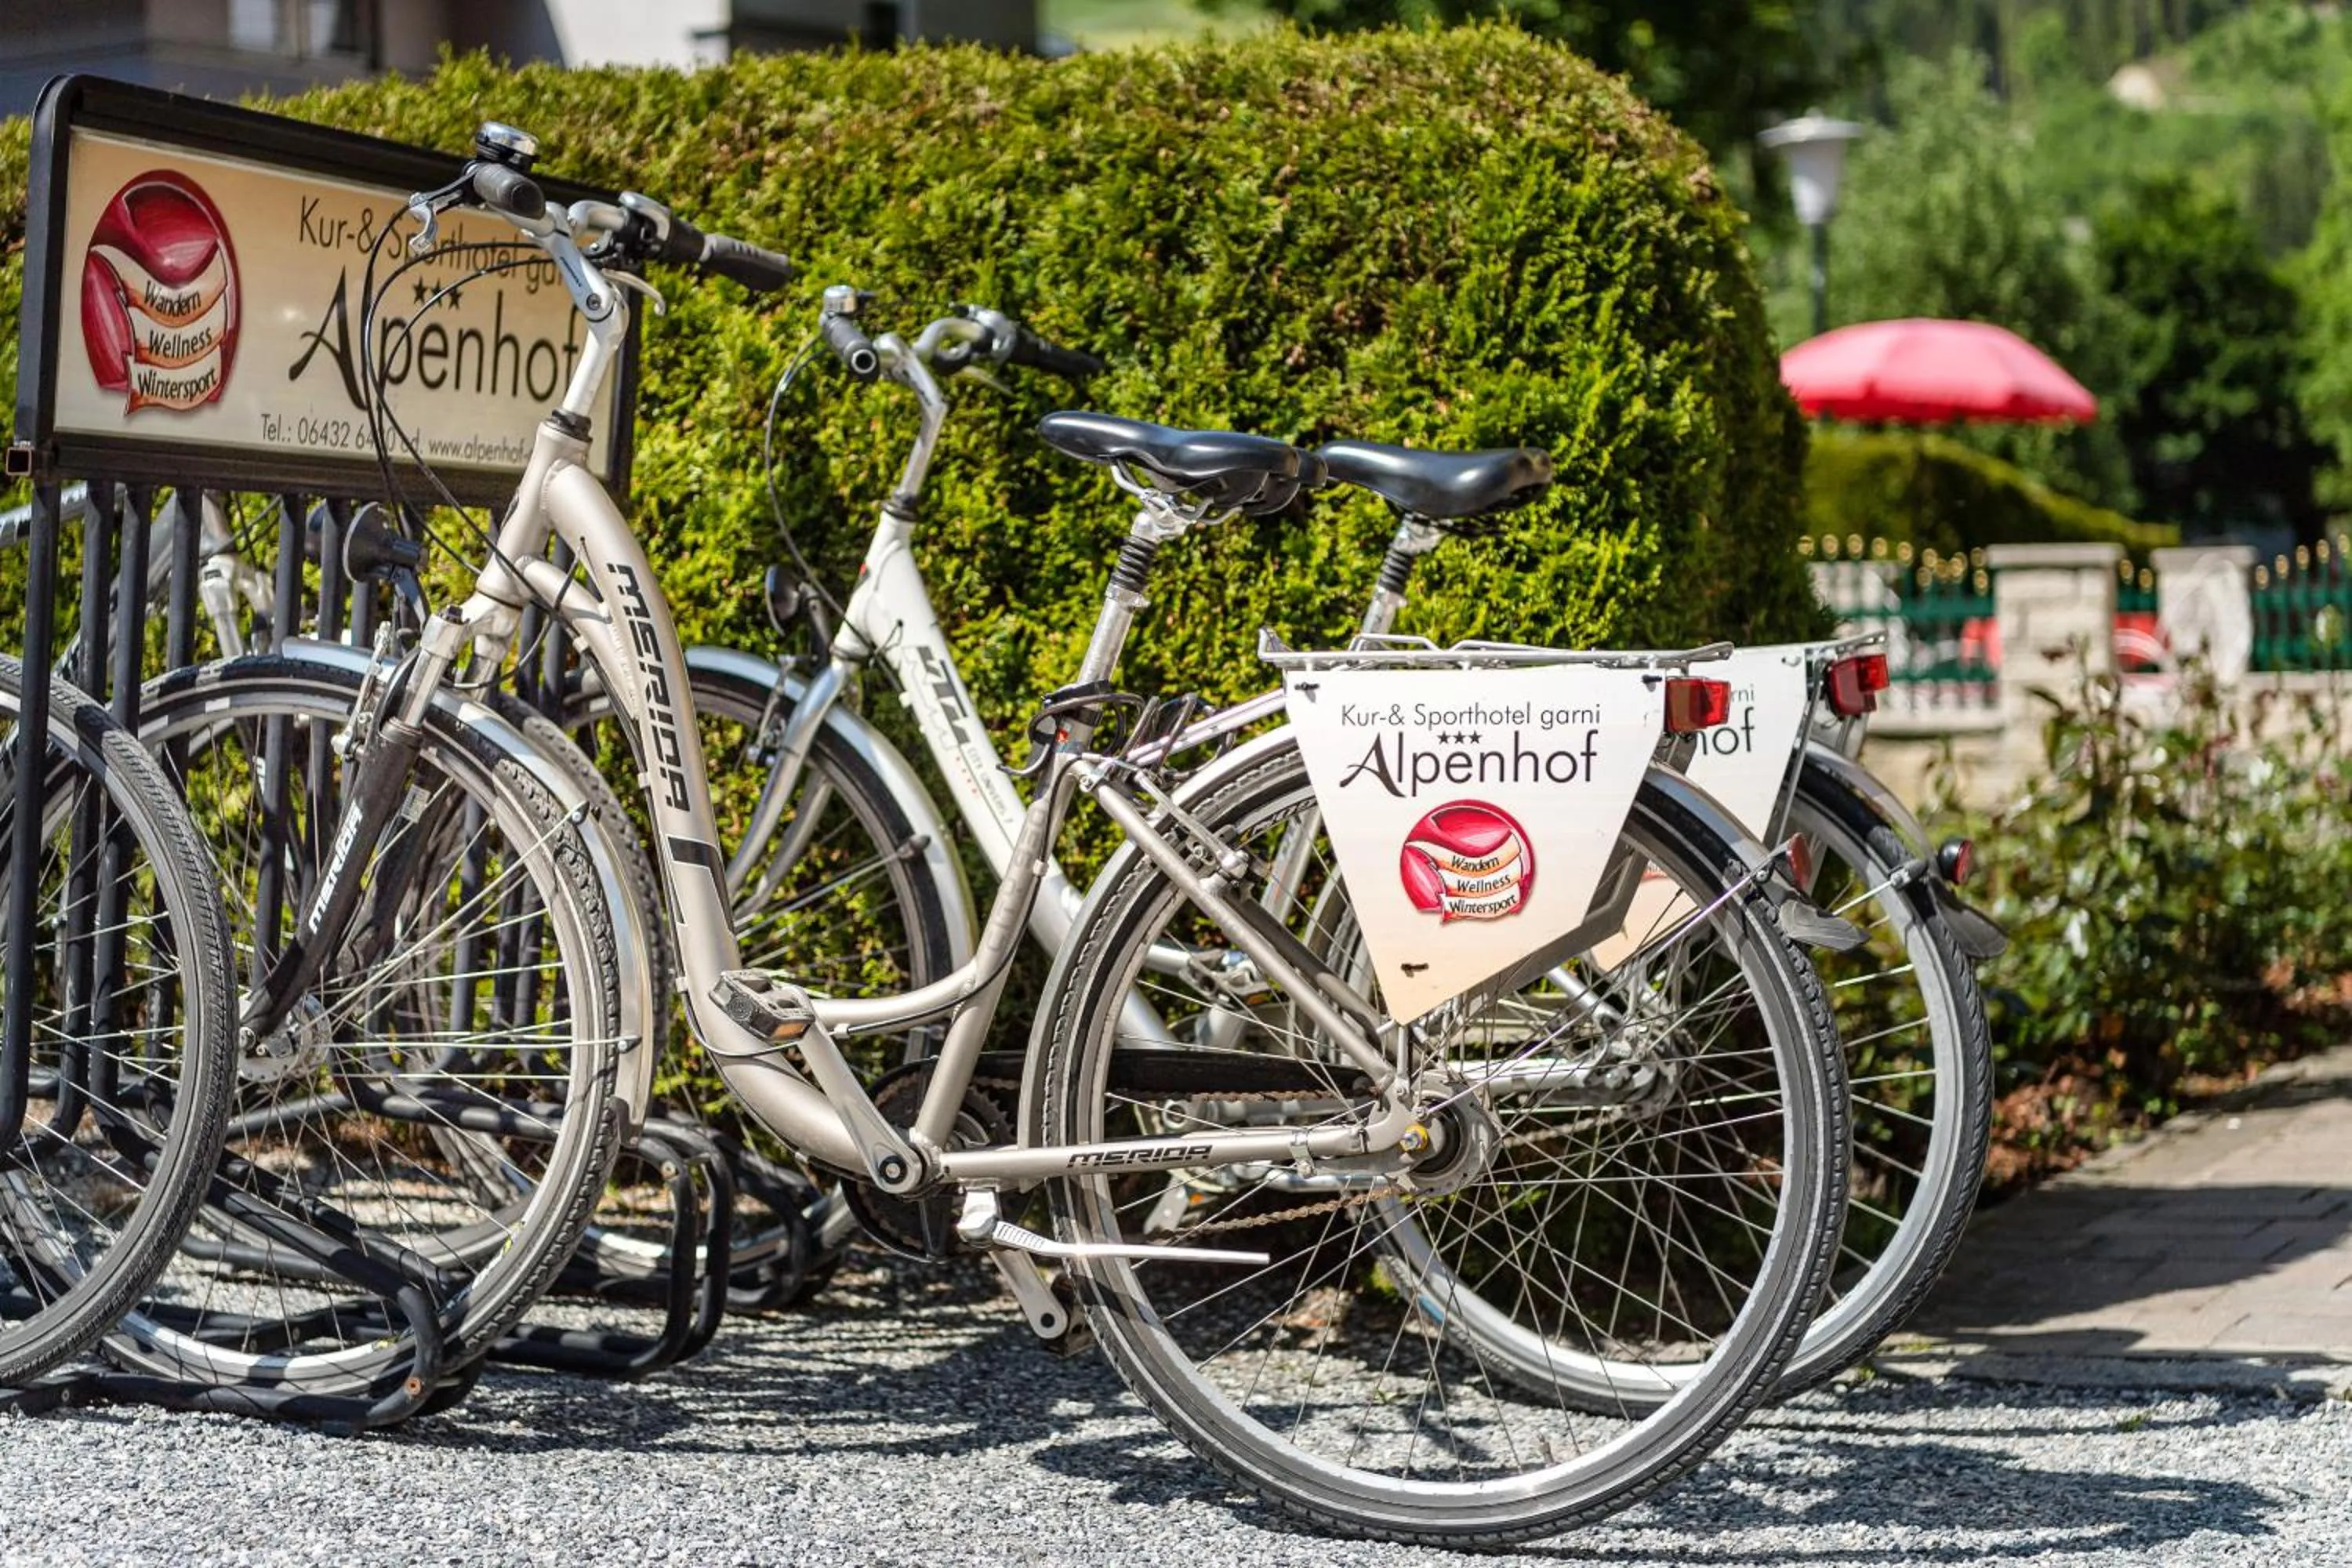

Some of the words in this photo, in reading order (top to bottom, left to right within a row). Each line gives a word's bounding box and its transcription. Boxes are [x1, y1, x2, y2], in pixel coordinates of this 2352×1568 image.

[143, 280, 201, 317] Wandern
[149, 327, 212, 359] Wellness
[137, 367, 217, 402] Wintersport
[261, 413, 291, 442] Tel.:
[297, 416, 351, 448] 06432
[355, 423, 396, 452] 640
[606, 562, 691, 812] MERIDA
[901, 645, 971, 751] KTM
[1341, 703, 1405, 727] Kur-&
[1413, 701, 1531, 730] Sporthotel
[1540, 703, 1601, 730] garni
[1339, 729, 1599, 797] Alpenhof
[308, 799, 363, 935] MERIDA
[1450, 855, 1500, 872] Wandern
[1457, 874, 1511, 893] Wellness
[1449, 894, 1519, 914] Wintersport
[1067, 1144, 1213, 1169] MERIDA
